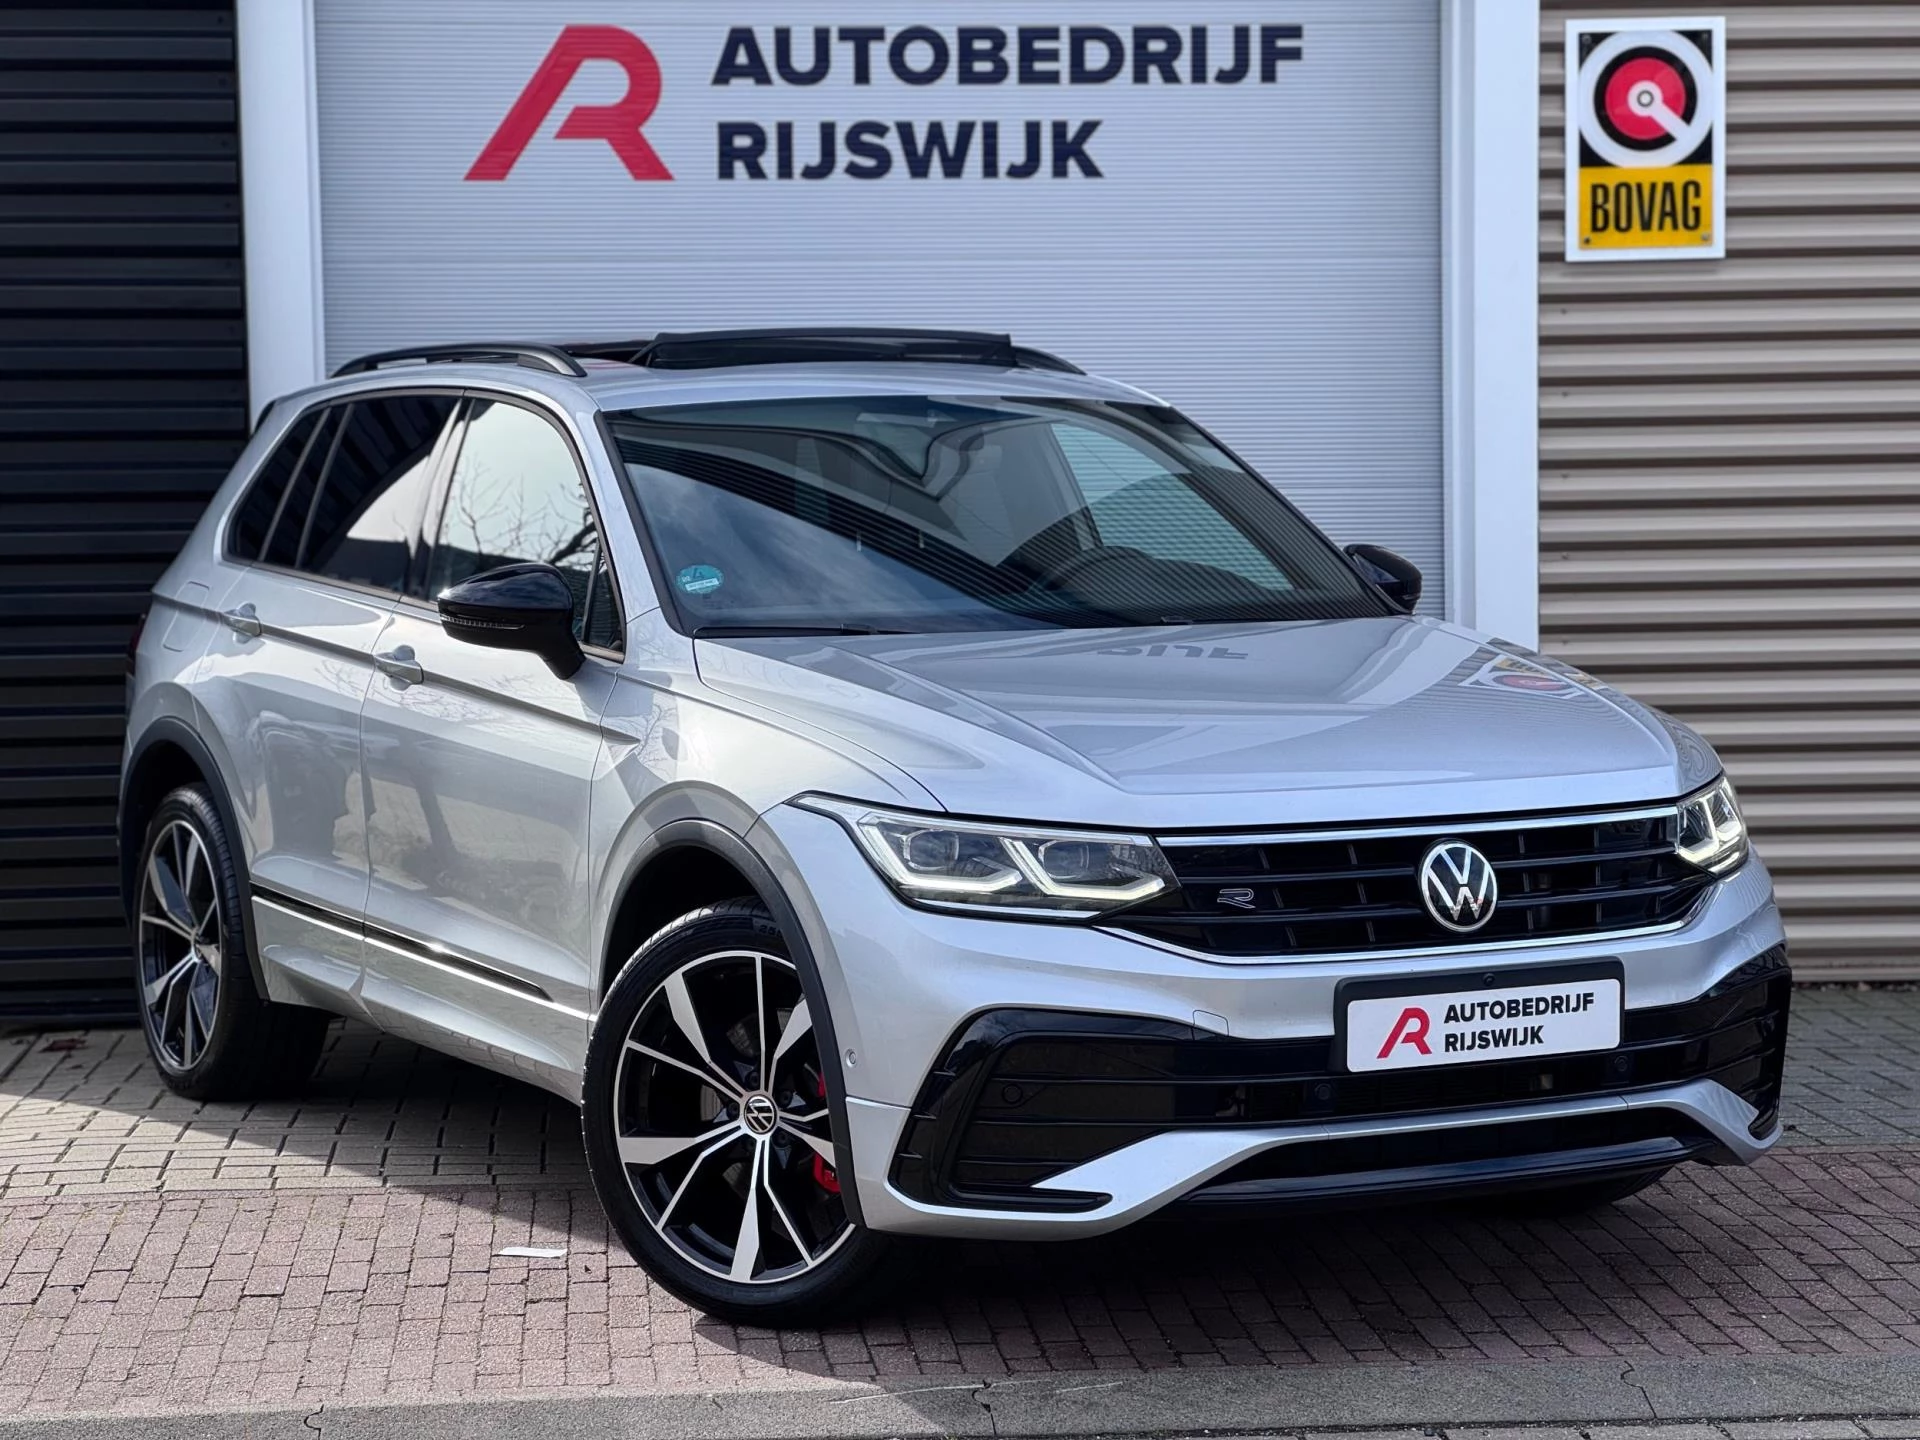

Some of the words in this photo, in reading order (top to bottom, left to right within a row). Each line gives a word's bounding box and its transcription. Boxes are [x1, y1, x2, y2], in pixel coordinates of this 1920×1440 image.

[711, 25, 1304, 86] AUTOBEDRIJF
[717, 119, 1104, 180] RIJSWIJK
[1590, 181, 1702, 233] BOVAG
[1443, 992, 1595, 1024] AUTOBEDRIJF
[1444, 1025, 1544, 1052] RIJSWIJK
